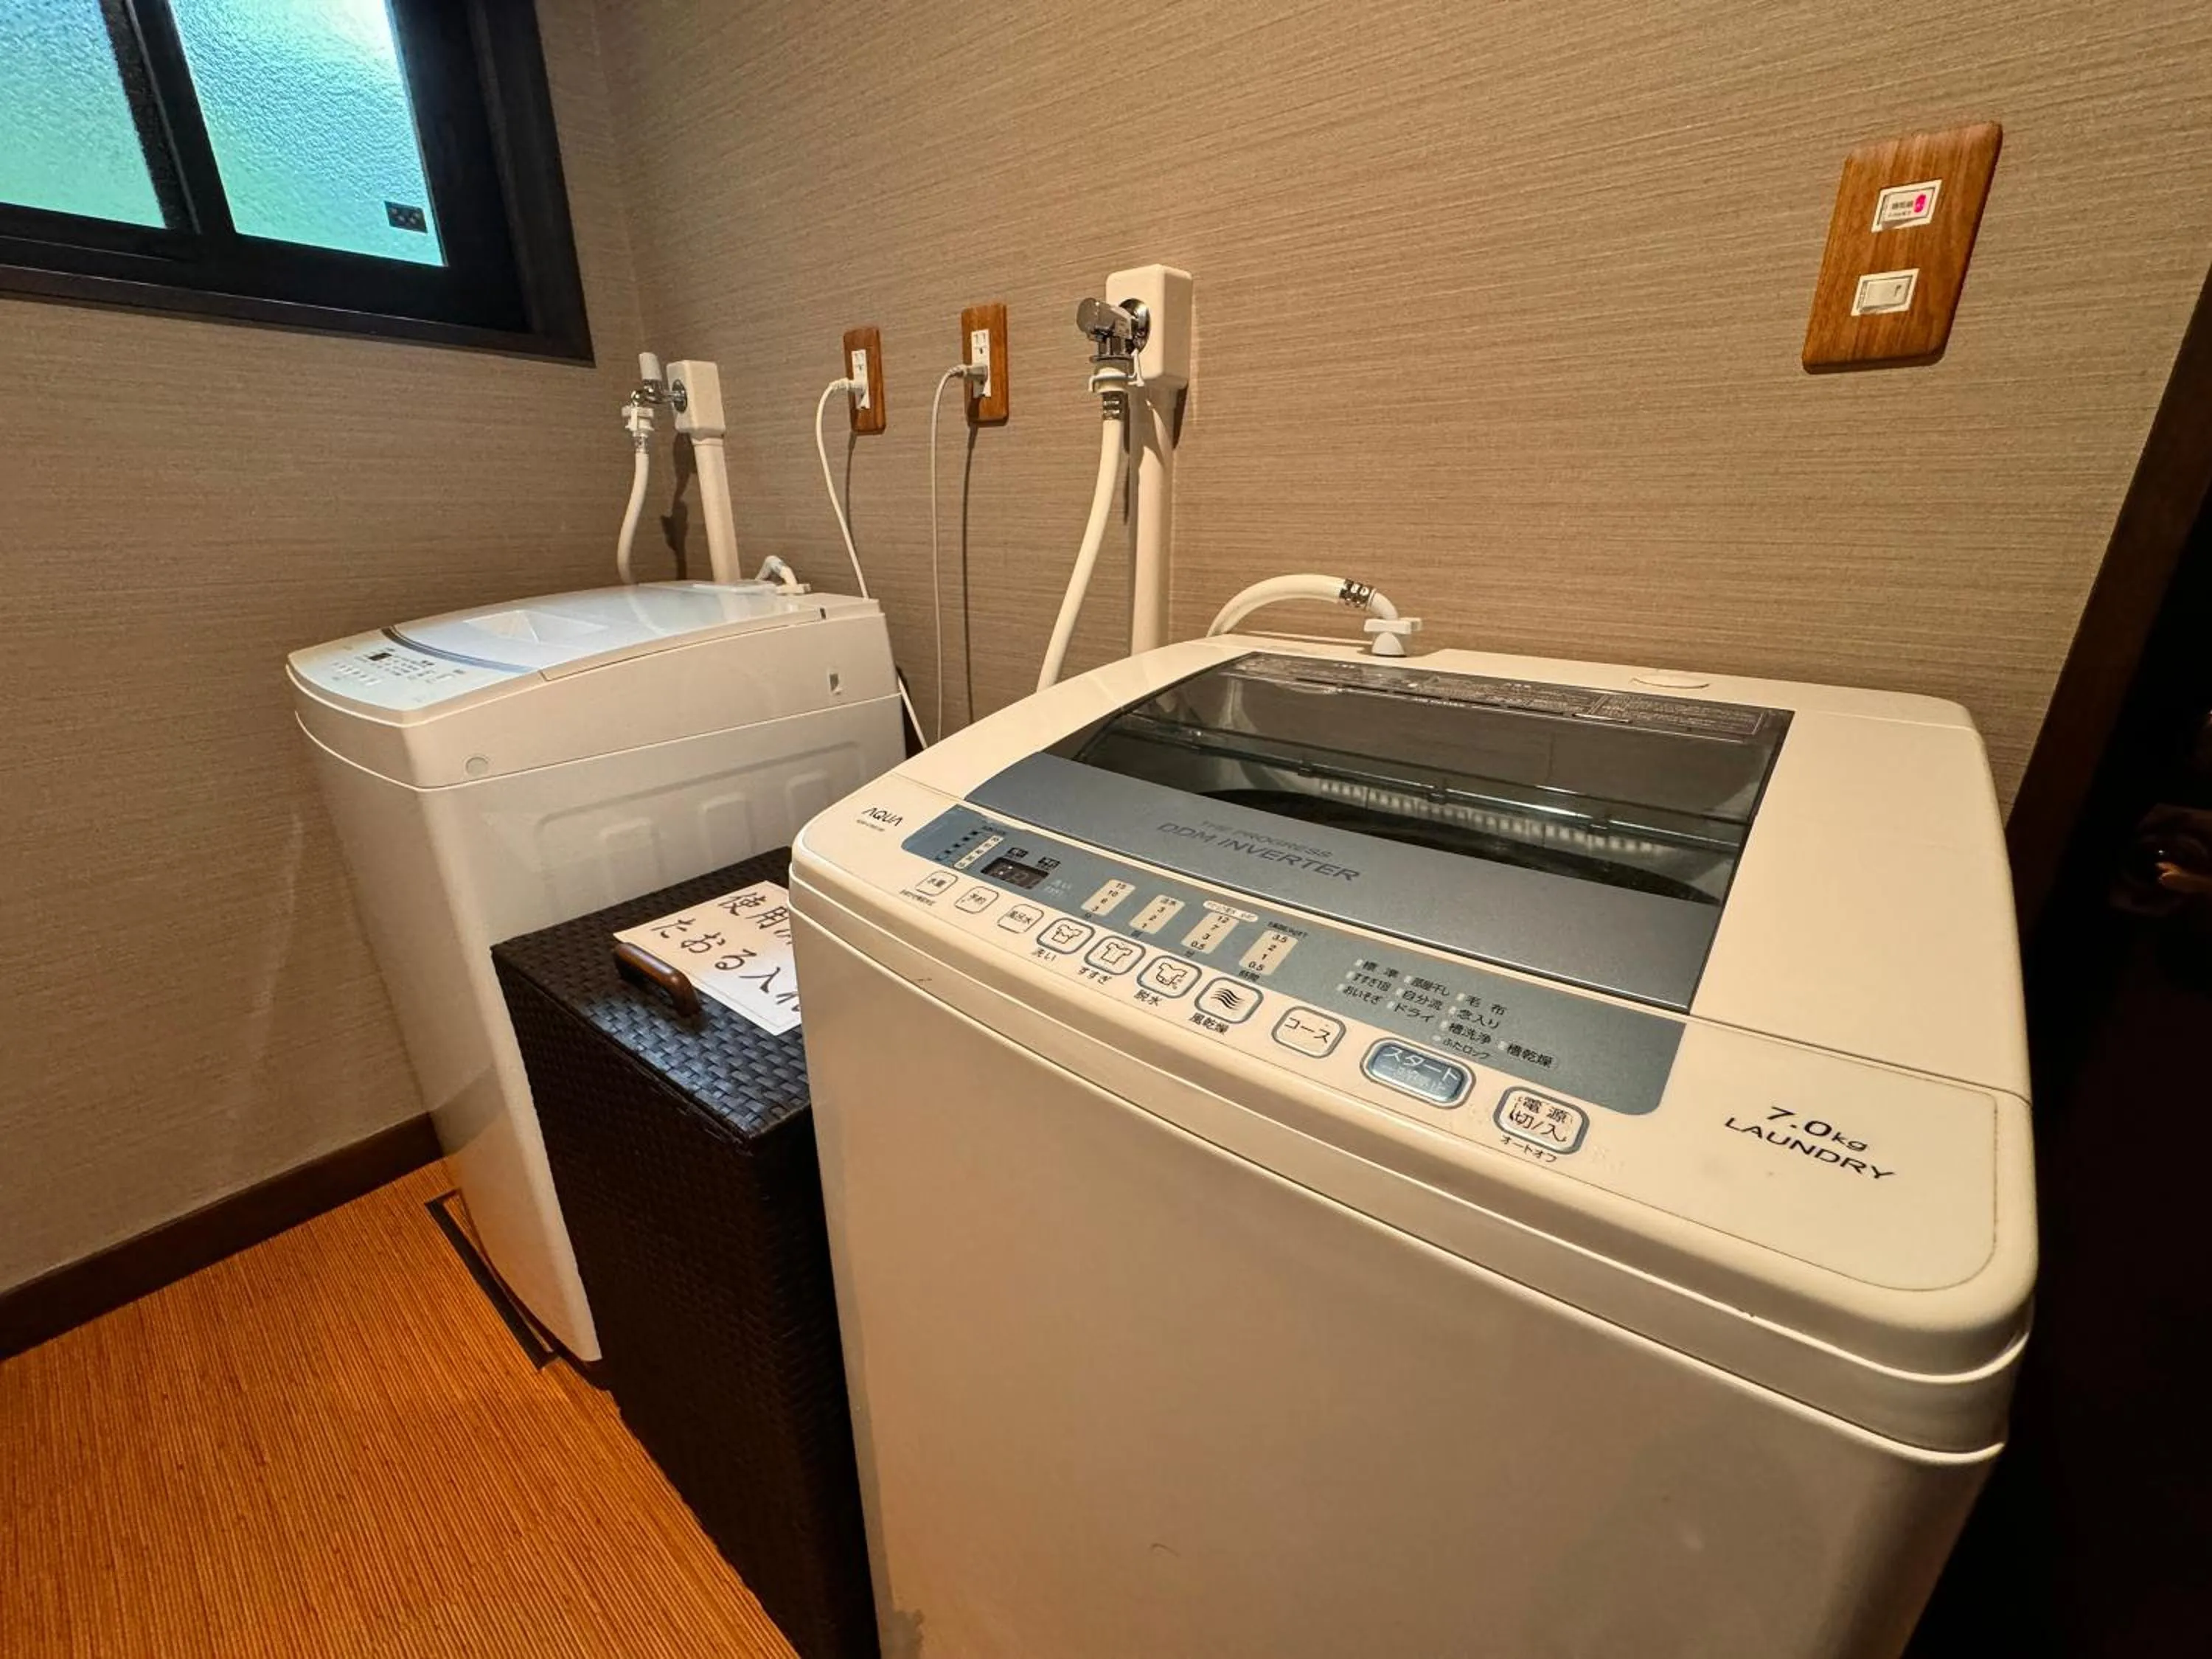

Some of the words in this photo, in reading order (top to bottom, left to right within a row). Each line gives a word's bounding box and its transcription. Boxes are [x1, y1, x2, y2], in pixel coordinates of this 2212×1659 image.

[861, 807, 902, 827] AQUA
[1157, 822, 1217, 843] DDM
[1217, 838, 1360, 881] INVERTER
[1233, 829, 1334, 858] PROGRESS
[718, 892, 793, 945] 使用
[1217, 914, 1230, 923] 12
[1191, 940, 1206, 950] 0.5
[1267, 944, 1277, 952] 2
[1272, 933, 1288, 943] 3.5
[1077, 967, 1112, 985] すすぎ
[1248, 961, 1265, 972] 0.5
[1133, 989, 1163, 1006] 脱水
[1343, 985, 1383, 1005] おいそぎ
[1402, 990, 1443, 1010] 自分流
[1189, 1012, 1230, 1034] 風乾燥
[1394, 1002, 1434, 1023] ドライ
[1457, 1009, 1499, 1029] 念入り
[1284, 1017, 1331, 1043] コース
[1448, 1023, 1492, 1044] 槽洗浄
[1442, 1037, 1491, 1060] ふたロック
[1507, 1043, 1554, 1068] 槽乾燥
[1382, 1046, 1458, 1082] スタート
[1523, 1096, 1568, 1123] 電源
[1515, 1110, 1568, 1142] 切/入
[1767, 1106, 1868, 1152] 7.0kg
[1500, 1135, 1557, 1163] オートオフ
[1724, 1116, 1896, 1180] LAUNDRY
